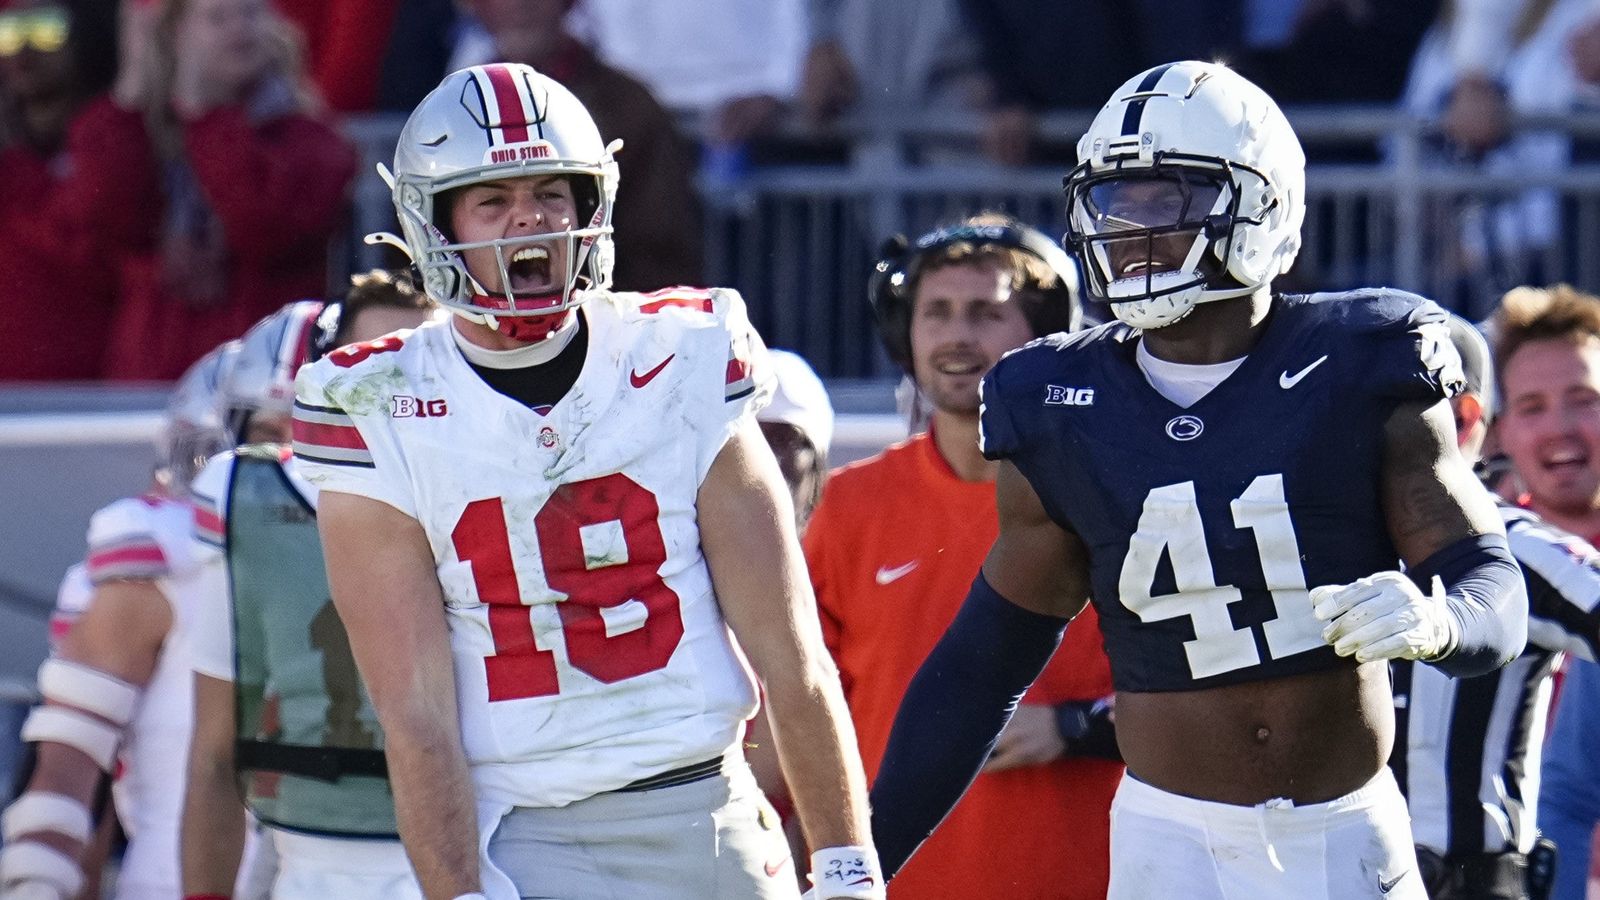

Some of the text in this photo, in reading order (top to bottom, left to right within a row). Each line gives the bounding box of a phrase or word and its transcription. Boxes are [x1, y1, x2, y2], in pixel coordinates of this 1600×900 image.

[491, 145, 549, 163] OHIO STATE
[451, 472, 685, 703] 18
[1118, 473, 1330, 680] 41
